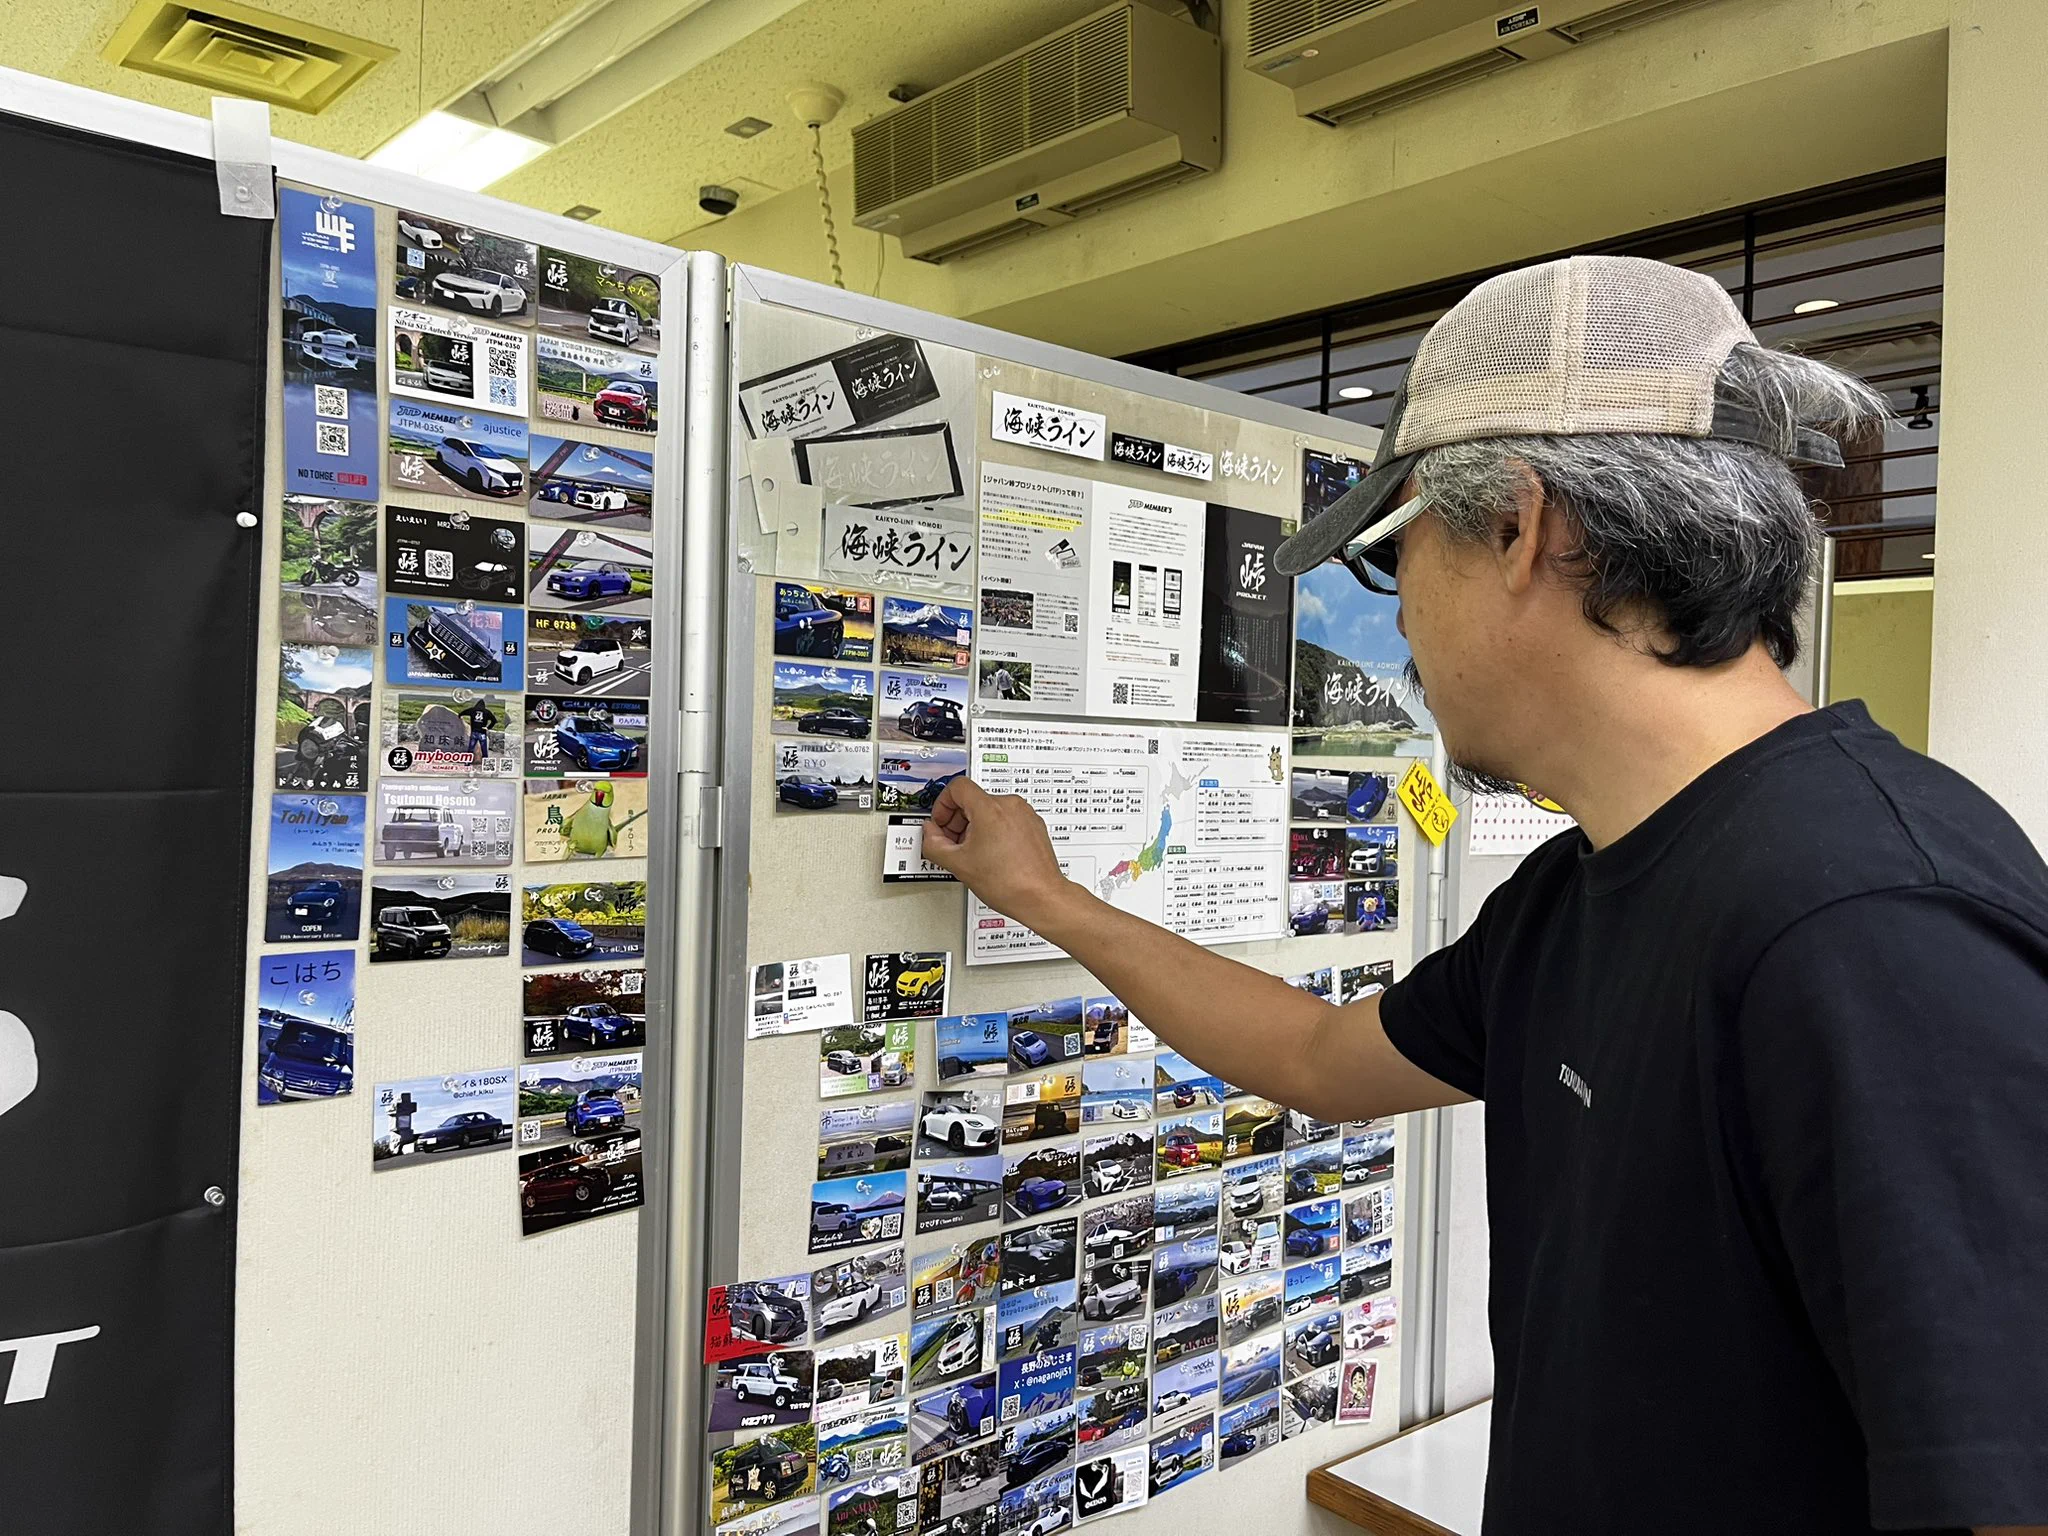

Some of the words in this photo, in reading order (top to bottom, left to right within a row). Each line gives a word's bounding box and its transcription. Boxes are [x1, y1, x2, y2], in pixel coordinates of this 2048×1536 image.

[395, 318, 414, 329] Silvia
[415, 322, 427, 331] S15
[427, 325, 452, 337] Autech
[452, 330, 478, 342] Version
[490, 331, 523, 343] MEMBER'S
[851, 360, 918, 400] 海峡ライン
[761, 391, 836, 433] 海峡ライン
[1057, 408, 1076, 417] AOMORI
[483, 422, 522, 438] ajustice
[1003, 407, 1096, 449] 海峡ライン
[1113, 441, 1162, 464] 海峡ライン
[818, 449, 941, 490] 海峡ライン
[1166, 452, 1211, 474] 海峡ライン
[1219, 450, 1284, 485] 海峡ライン
[298, 468, 309, 479] NO
[1144, 503, 1173, 514] MEMBER'S
[436, 520, 451, 529] MR2
[842, 523, 972, 572] 海峡ライン
[535, 618, 550, 629] HF
[553, 618, 577, 631] 6738
[1324, 672, 1411, 708] 海峡ライン
[414, 750, 475, 764] myboom
[804, 758, 827, 768] RYO
[383, 793, 434, 807] Tsutomu
[435, 794, 476, 807] Hosono
[301, 924, 323, 933] COPEN
[268, 959, 343, 987] こはち
[898, 999, 943, 1010] SWIFT
[608, 1058, 638, 1068] MEMBER'S
[452, 1087, 494, 1100] @chief_kiku
[918, 1147, 931, 1156] トモ
